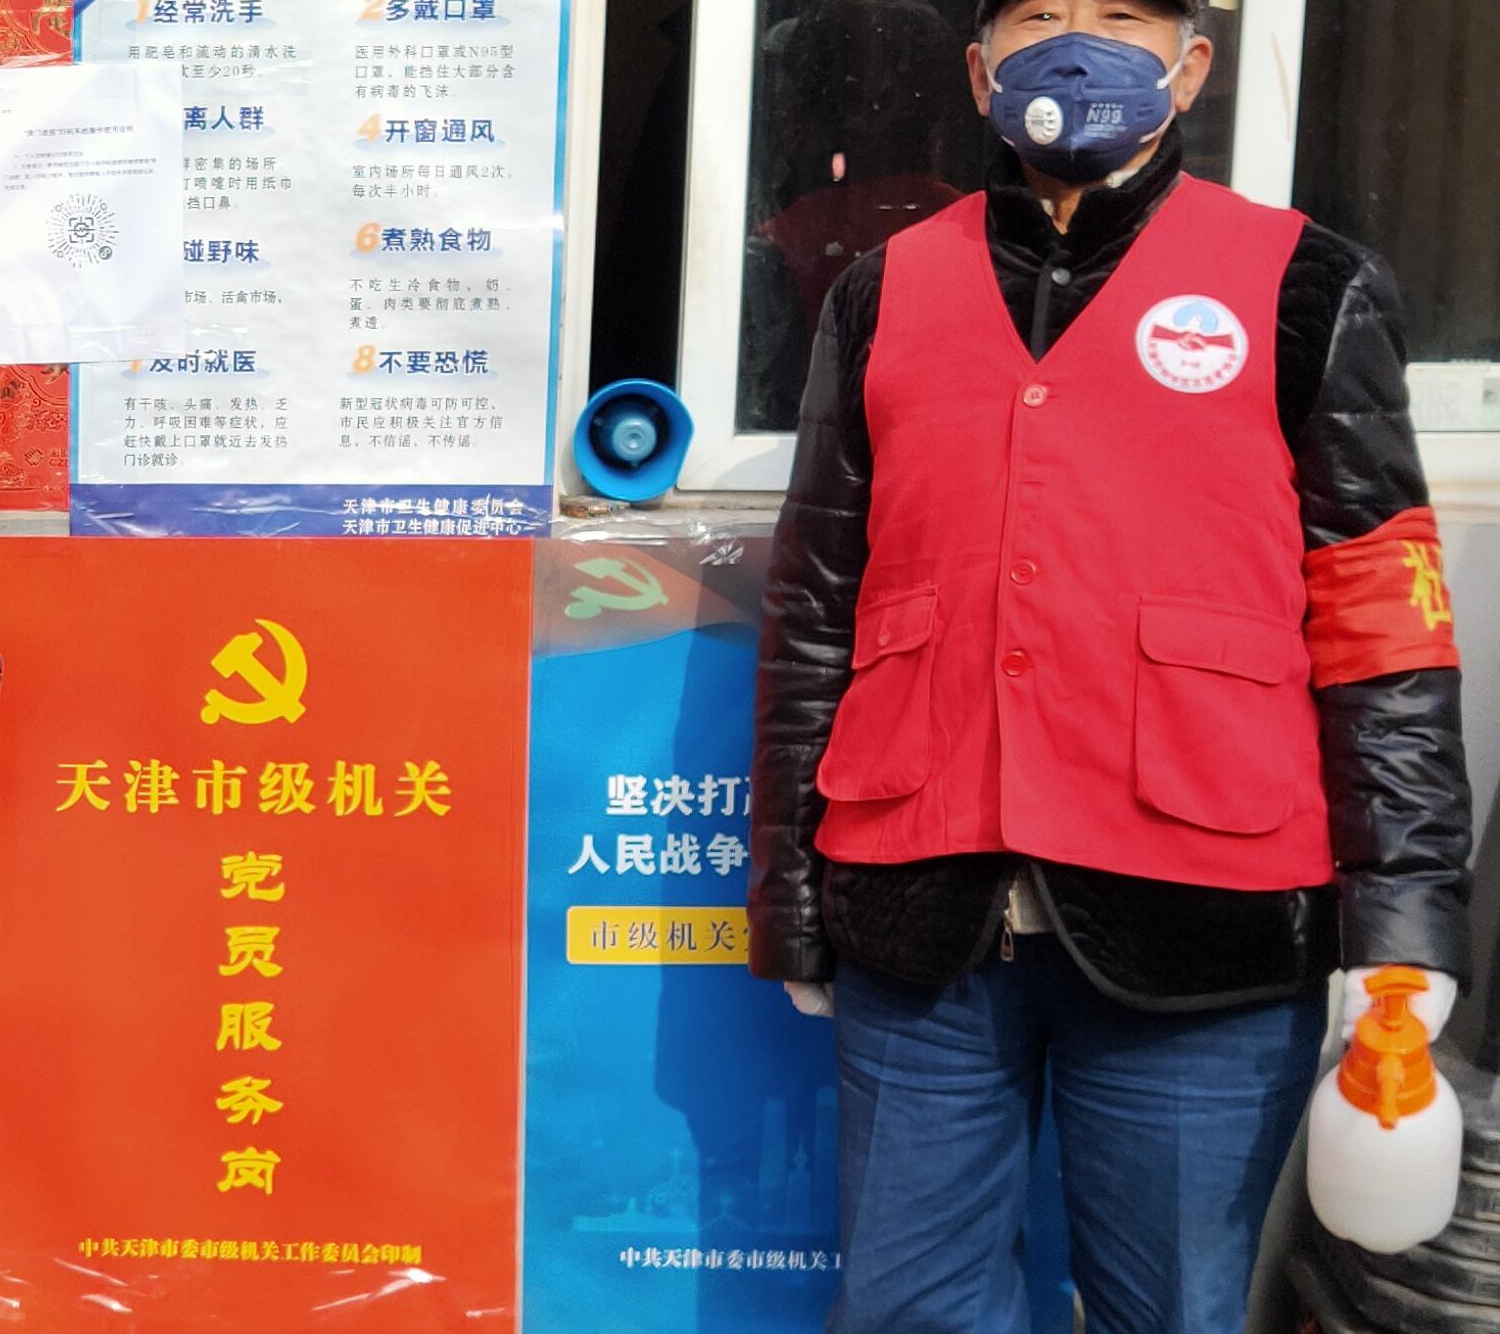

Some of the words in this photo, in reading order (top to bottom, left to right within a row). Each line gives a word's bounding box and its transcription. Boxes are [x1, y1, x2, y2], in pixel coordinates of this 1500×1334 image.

[128, 45, 299, 59] 用肥皂和流动的清水洗
[355, 45, 514, 59] 医用外科口罩或N95型
[182, 105, 265, 131] 离人群
[340, 415, 503, 430] 市民应积极关注官方信
[124, 434, 288, 449] 赶快戴上口罩就近去发热
[343, 498, 525, 516] 天津市卫生健康委员会
[343, 517, 523, 536] 天津市卫生健康促进中心
[55, 758, 453, 817] 天津市级机关
[606, 774, 750, 818] 坚决打
[567, 832, 749, 877] 人民战争
[590, 919, 750, 953] 市级机关
[214, 850, 285, 1195] 党员服务岗
[77, 1236, 423, 1266] 中共天津市委市级机关工作委员会印制
